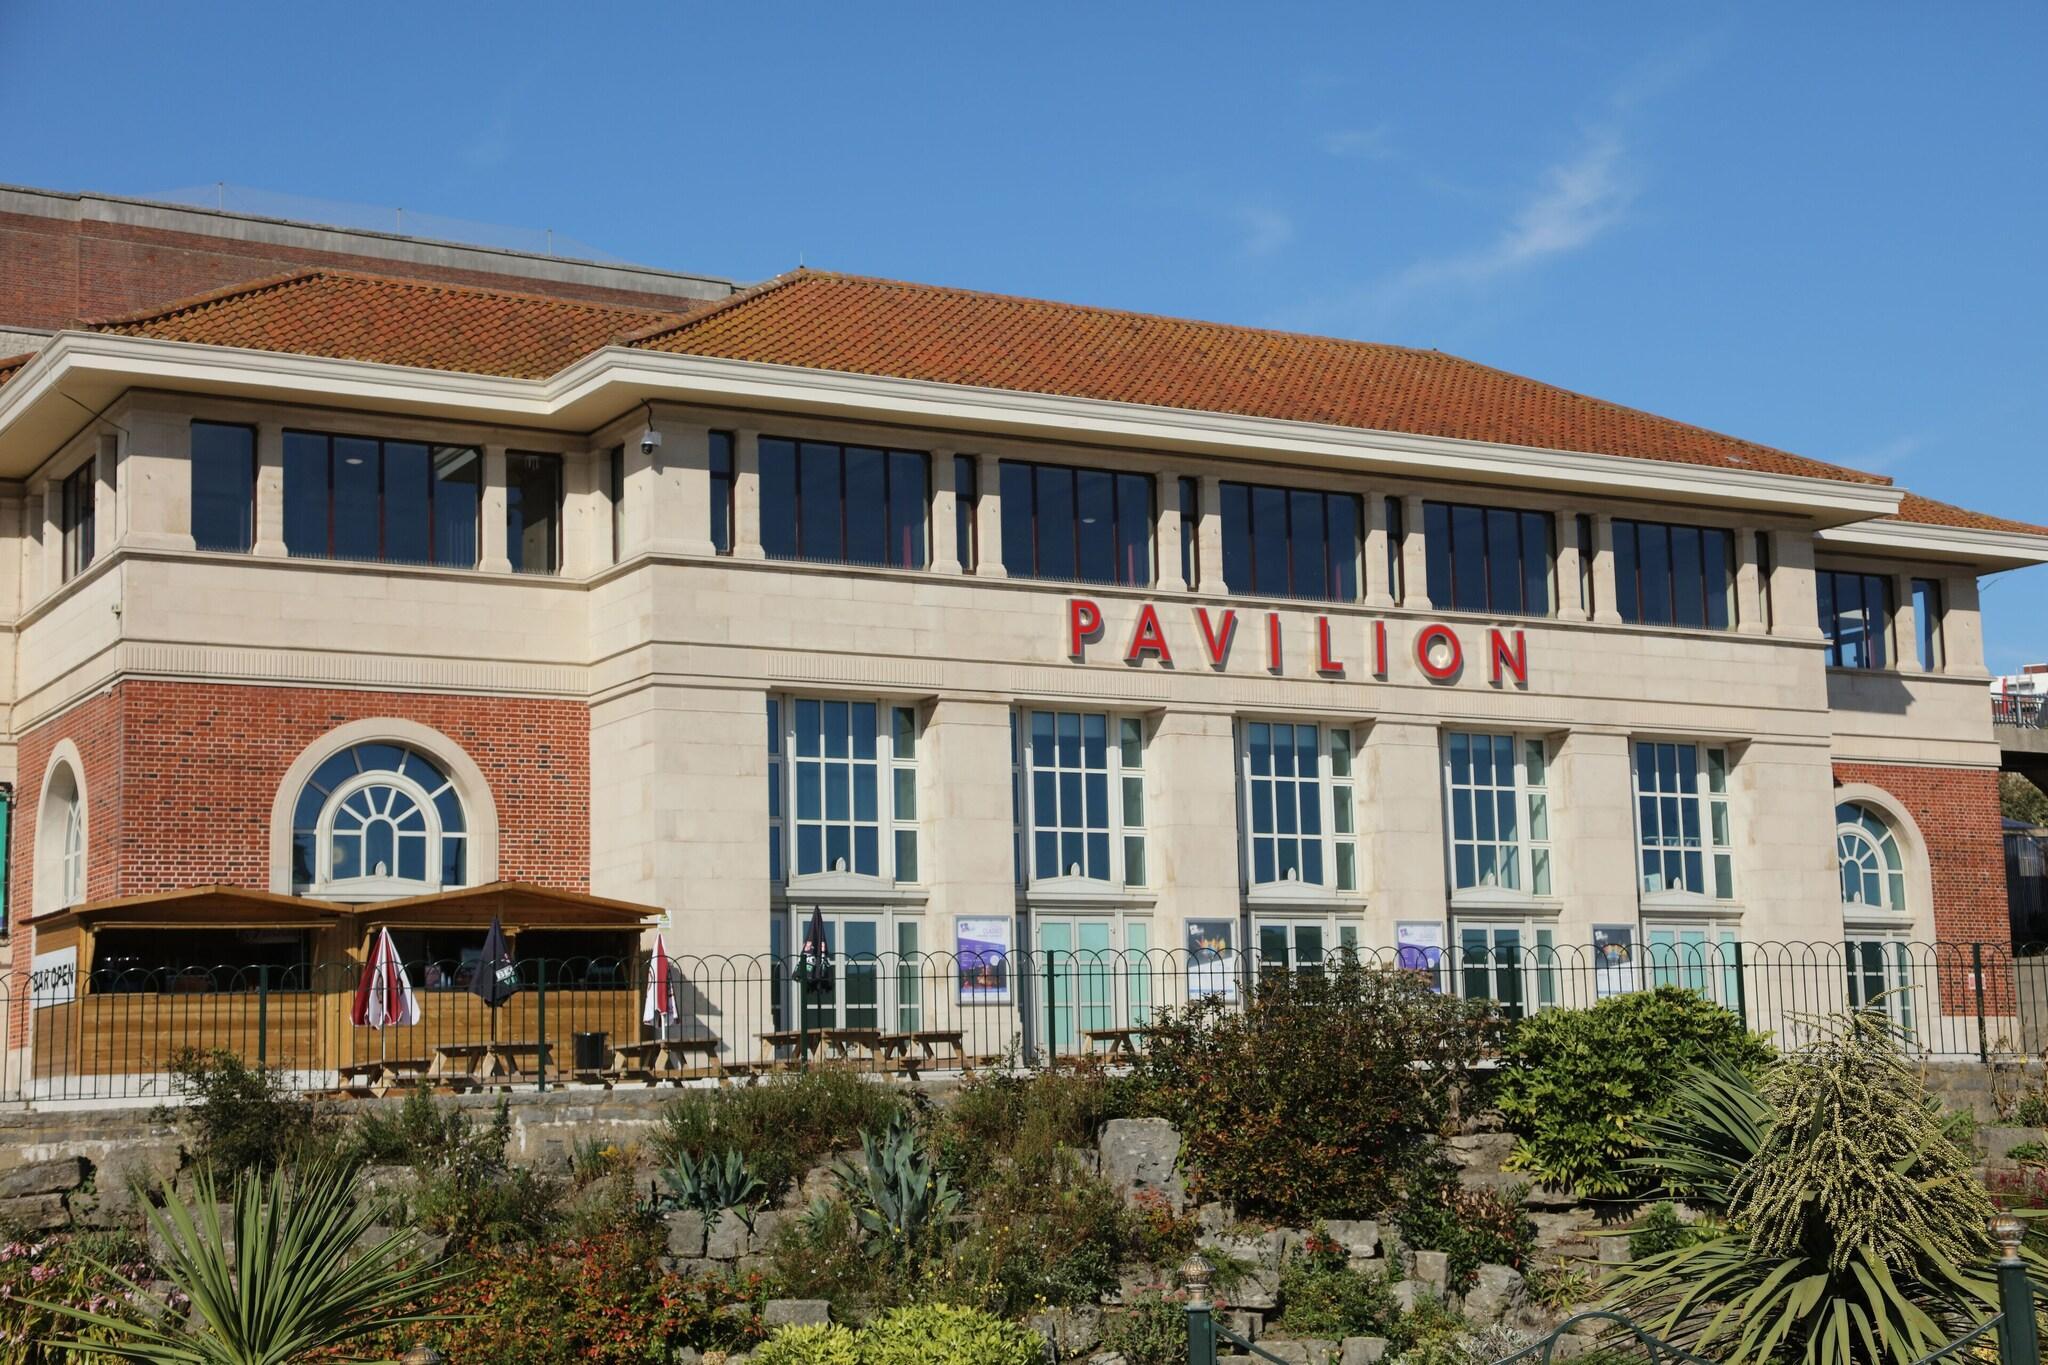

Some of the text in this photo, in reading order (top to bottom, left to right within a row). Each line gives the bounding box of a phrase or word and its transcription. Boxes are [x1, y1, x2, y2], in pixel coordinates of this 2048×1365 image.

[1068, 598, 1527, 684] PAVILION
[33, 962, 74, 992] BAR OPEN
